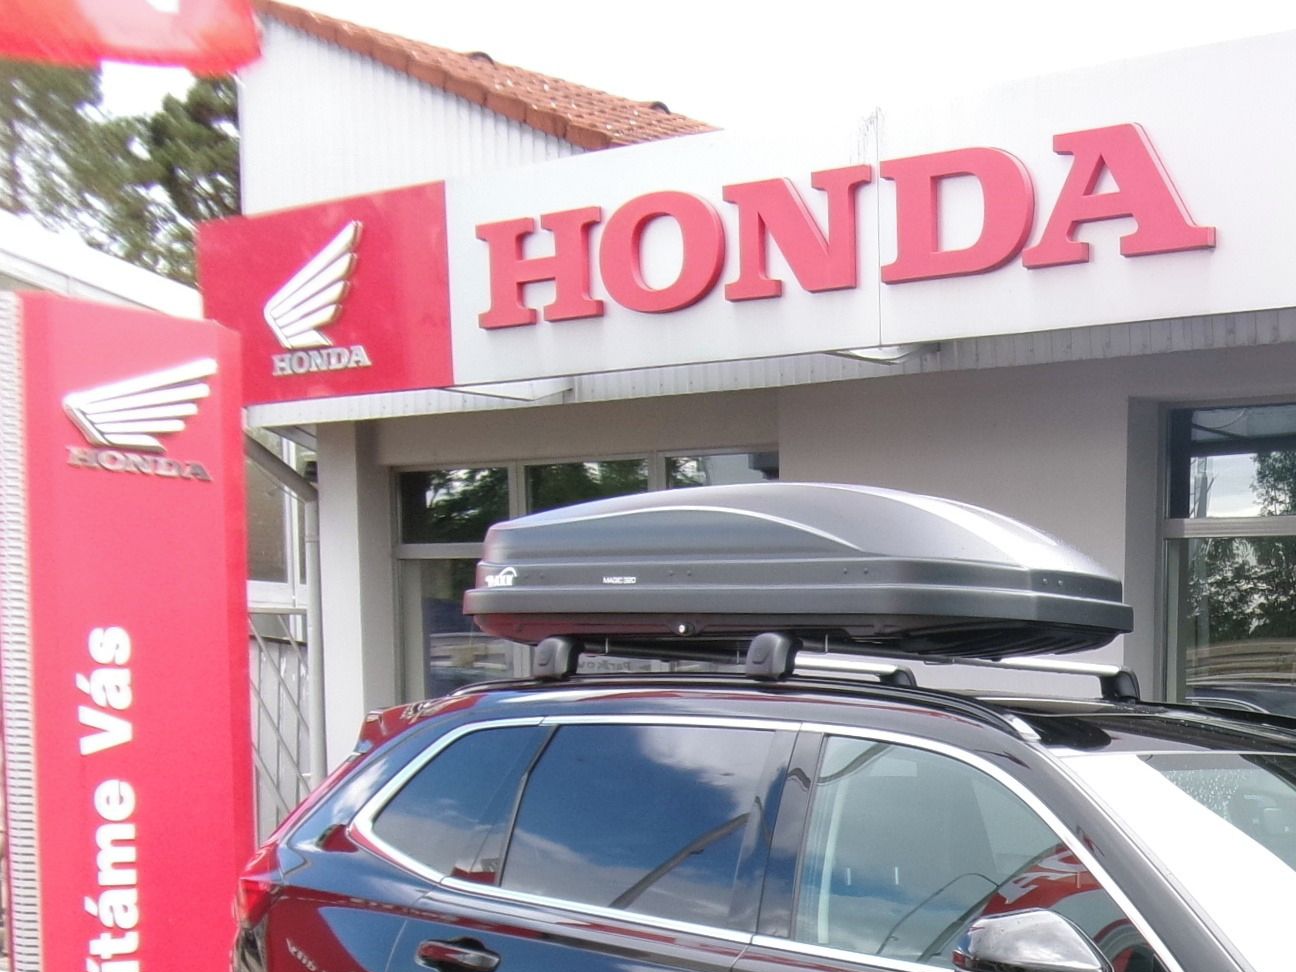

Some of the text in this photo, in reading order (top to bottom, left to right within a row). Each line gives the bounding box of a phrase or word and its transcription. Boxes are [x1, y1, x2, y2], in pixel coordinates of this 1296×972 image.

[475, 121, 1217, 330] HONDA
[271, 344, 373, 377] HONDA
[65, 445, 213, 482] HONDA
[76, 625, 134, 757] Vás
